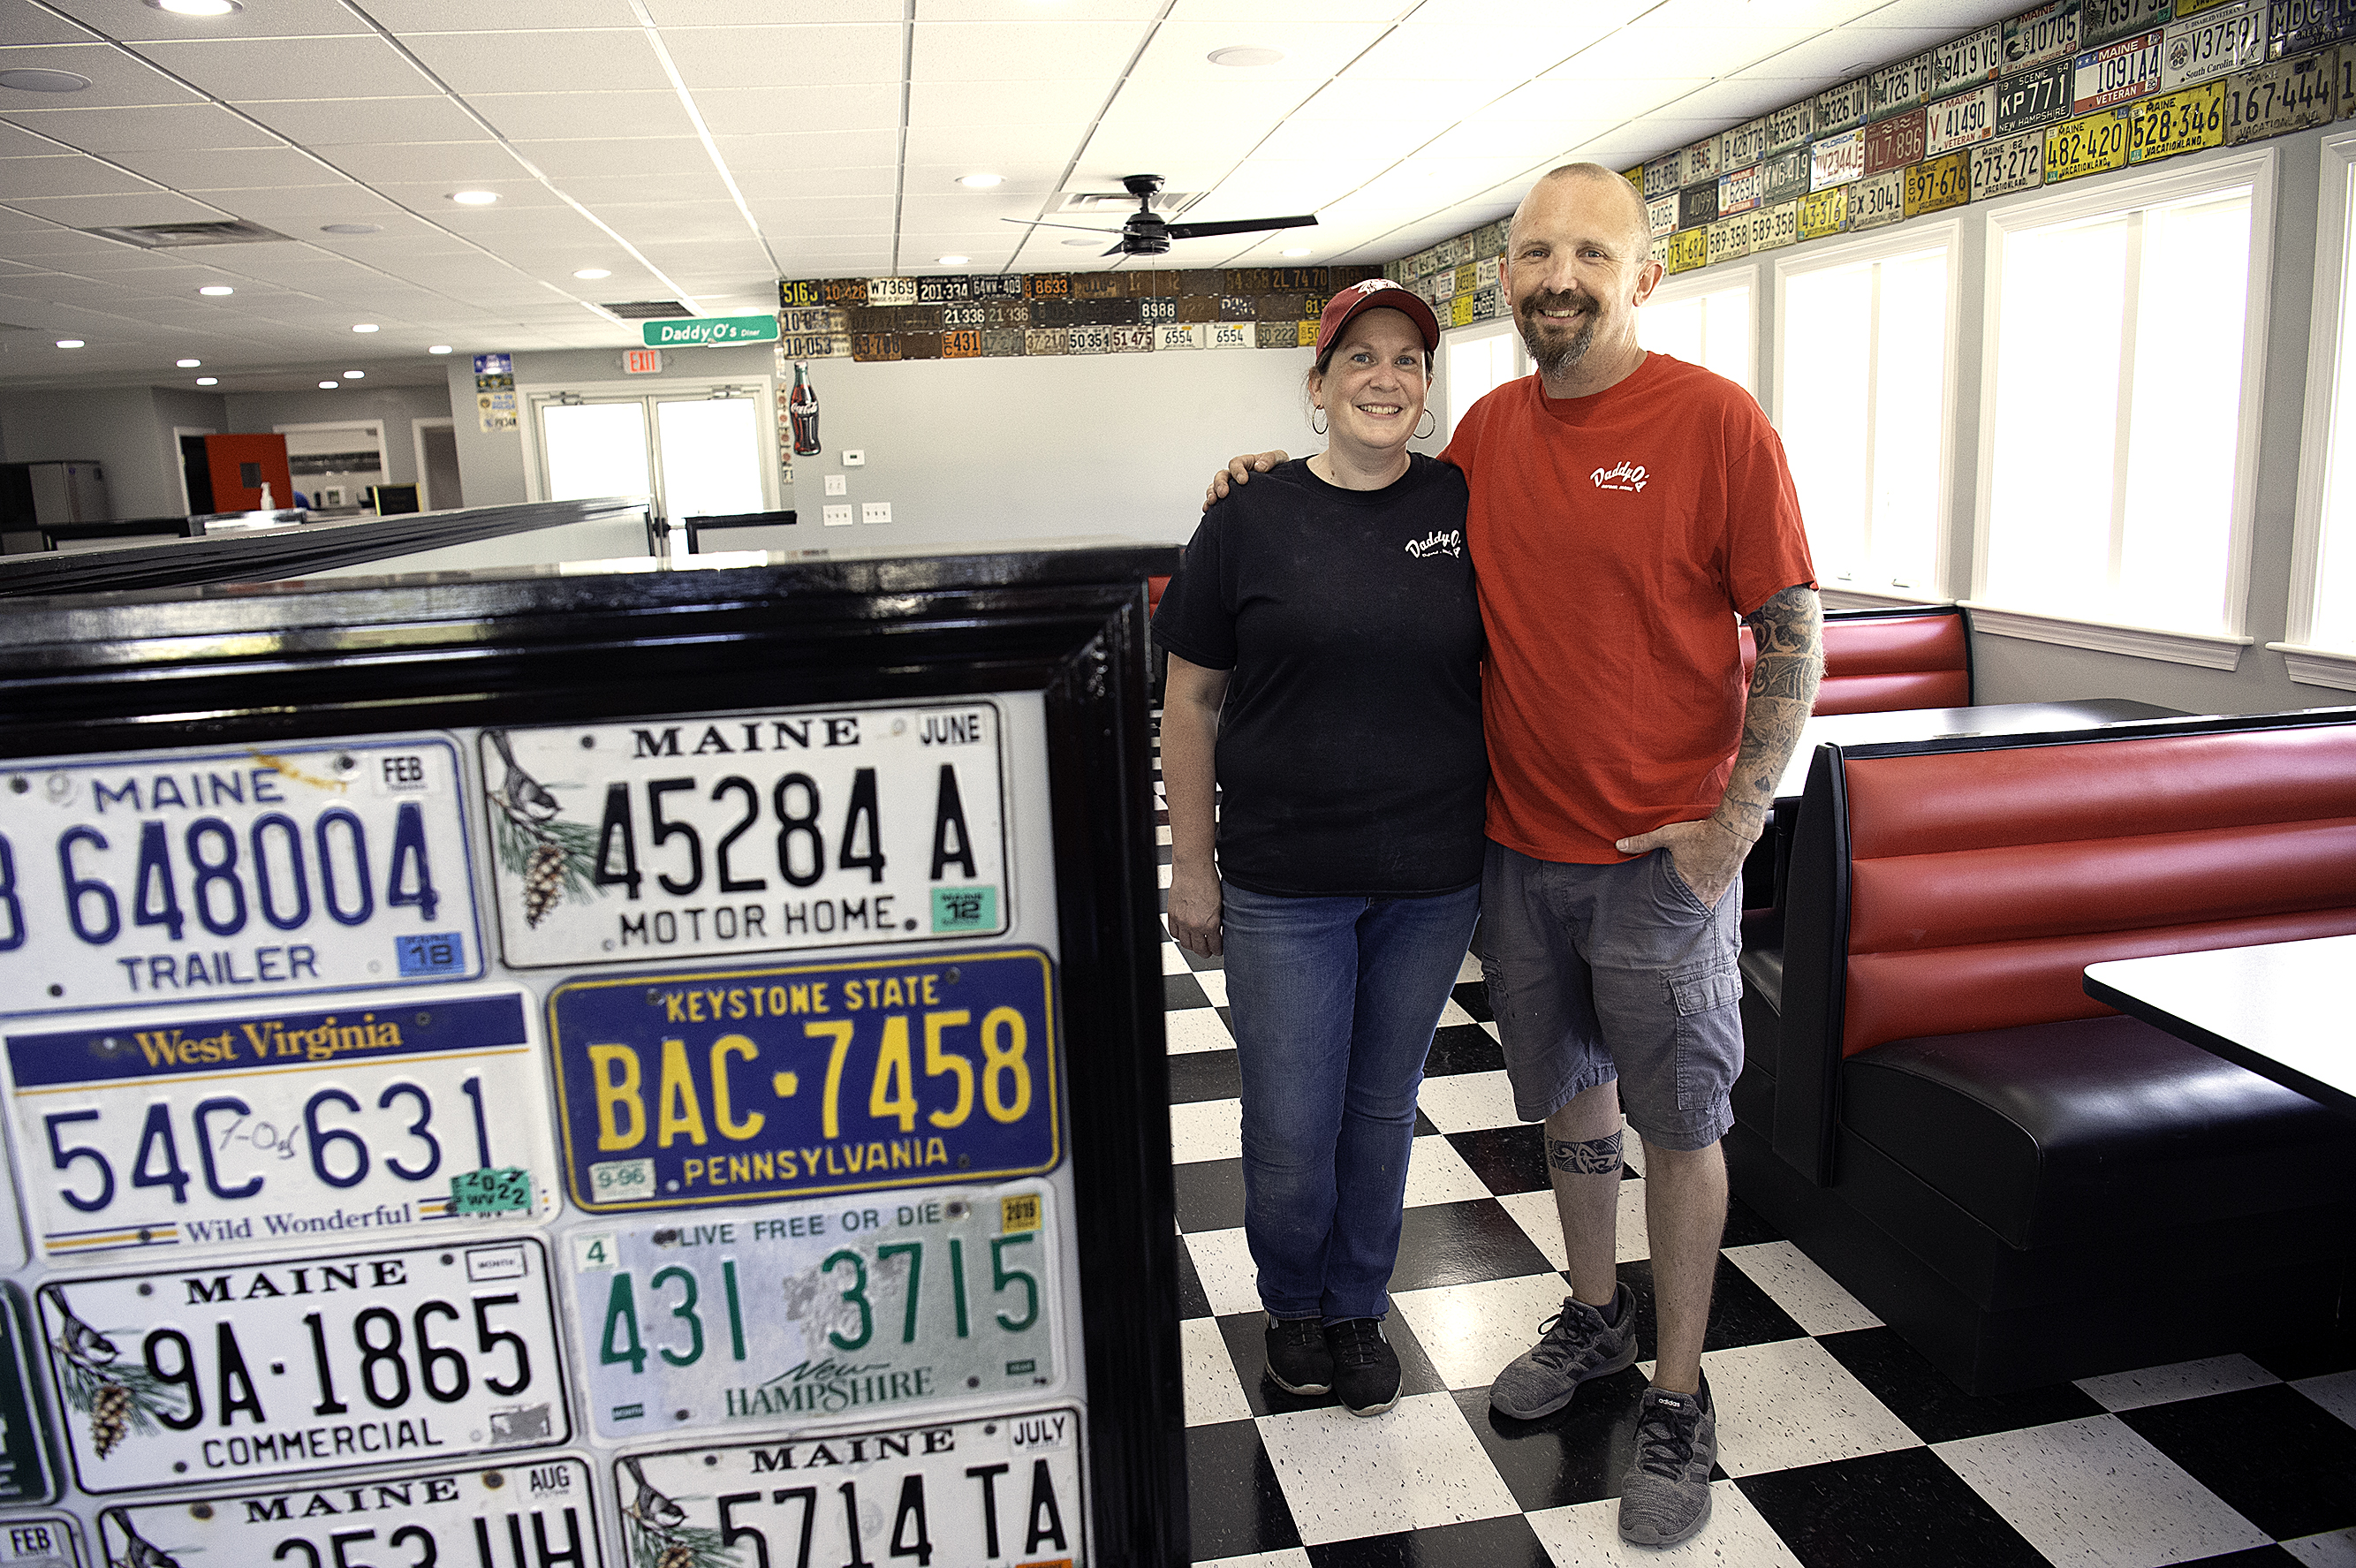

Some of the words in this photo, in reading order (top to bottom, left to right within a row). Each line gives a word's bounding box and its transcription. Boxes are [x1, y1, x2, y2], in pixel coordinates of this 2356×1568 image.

[2021, 4, 2056, 24] MAINE
[1952, 33, 1981, 51] MAINE
[2030, 13, 2076, 53] 10705
[2192, 12, 2261, 63] V37591
[1944, 45, 1977, 83] 9419
[1981, 38, 1997, 69] VG
[2098, 40, 2139, 61] MAINE
[1888, 58, 1915, 75] MAINE
[1914, 64, 1928, 94] TG
[2019, 69, 2049, 86] SCENIC
[2057, 63, 2069, 73] 64
[2096, 45, 2159, 94] 1091A4
[2186, 67, 2206, 80] South
[2207, 58, 2237, 73] Carolin
[1830, 83, 1854, 98] MAINE
[1946, 92, 1976, 109] MAINE
[2000, 74, 2065, 118] KP771
[2095, 86, 2137, 105] VETERAN
[1780, 104, 1802, 117] MAINE
[1824, 95, 1850, 127] 8326
[1999, 120, 2016, 132] NEW
[2019, 106, 2066, 127] HAMPSHIRE
[2146, 97, 2177, 114] MAINE
[1945, 101, 1985, 138] 41490
[2057, 122, 2085, 137] MAINE
[1821, 133, 1853, 150] FLORIDA
[1944, 133, 1975, 148] VETERAN
[1982, 144, 2004, 157] MAINE
[2146, 135, 2202, 156] VACATIONLAND
[1916, 162, 1937, 175] MAINE
[2061, 156, 2109, 177] VACATIONLAND
[1868, 182, 1901, 215] 3041
[871, 280, 914, 295] W7369
[1035, 279, 1068, 293] 8633
[1141, 303, 1176, 317] 8988
[661, 324, 711, 343] Daddy
[713, 323, 738, 338] O's
[953, 332, 979, 352] 431
[1165, 330, 1193, 344] 6554
[1216, 330, 1244, 343] 6554
[629, 350, 656, 373] EXIT
[632, 717, 861, 759] MAINE
[920, 714, 981, 747] JUNE
[383, 756, 423, 784] FEB
[92, 768, 286, 814] MAINE
[595, 766, 886, 900] 45284
[929, 762, 978, 881] A
[57, 801, 439, 946] 648004
[620, 903, 767, 949] MOTOR
[784, 895, 899, 936] HOME
[946, 901, 981, 920] 12
[118, 943, 321, 993] TRAILER
[408, 943, 453, 968] 18
[666, 982, 830, 1024] KEYSTONE
[845, 973, 941, 1011] STATE
[135, 1028, 240, 1068] West
[243, 1012, 404, 1061] Virginia
[44, 1096, 265, 1213] 54C
[303, 1075, 494, 1188] 631
[683, 1137, 949, 1187] PENNSYLVANIA
[186, 1218, 253, 1244] Wild
[264, 1203, 413, 1236] Wonderful
[678, 1223, 736, 1247] LIVE
[754, 1216, 826, 1242] FREE
[842, 1209, 881, 1231] OR
[898, 1203, 943, 1228] DIE
[586, 1240, 607, 1263] 4
[185, 1260, 409, 1306] MAINE
[600, 1261, 747, 1375] 431
[821, 1233, 1040, 1352] 3715
[759, 1356, 891, 1387] New
[725, 1366, 936, 1417] HAMPSHIRE
[1658, 1398, 1681, 1408] adidas
[203, 1417, 444, 1470] COMMERCIAL
[749, 1429, 956, 1475] MAINE
[1013, 1416, 1067, 1445] JULY
[245, 1478, 462, 1525] MAINE
[530, 1465, 571, 1493] AUG
[717, 1473, 934, 1568] 5714
[966, 1458, 1069, 1558] TA
[10, 1527, 51, 1555] FEB
